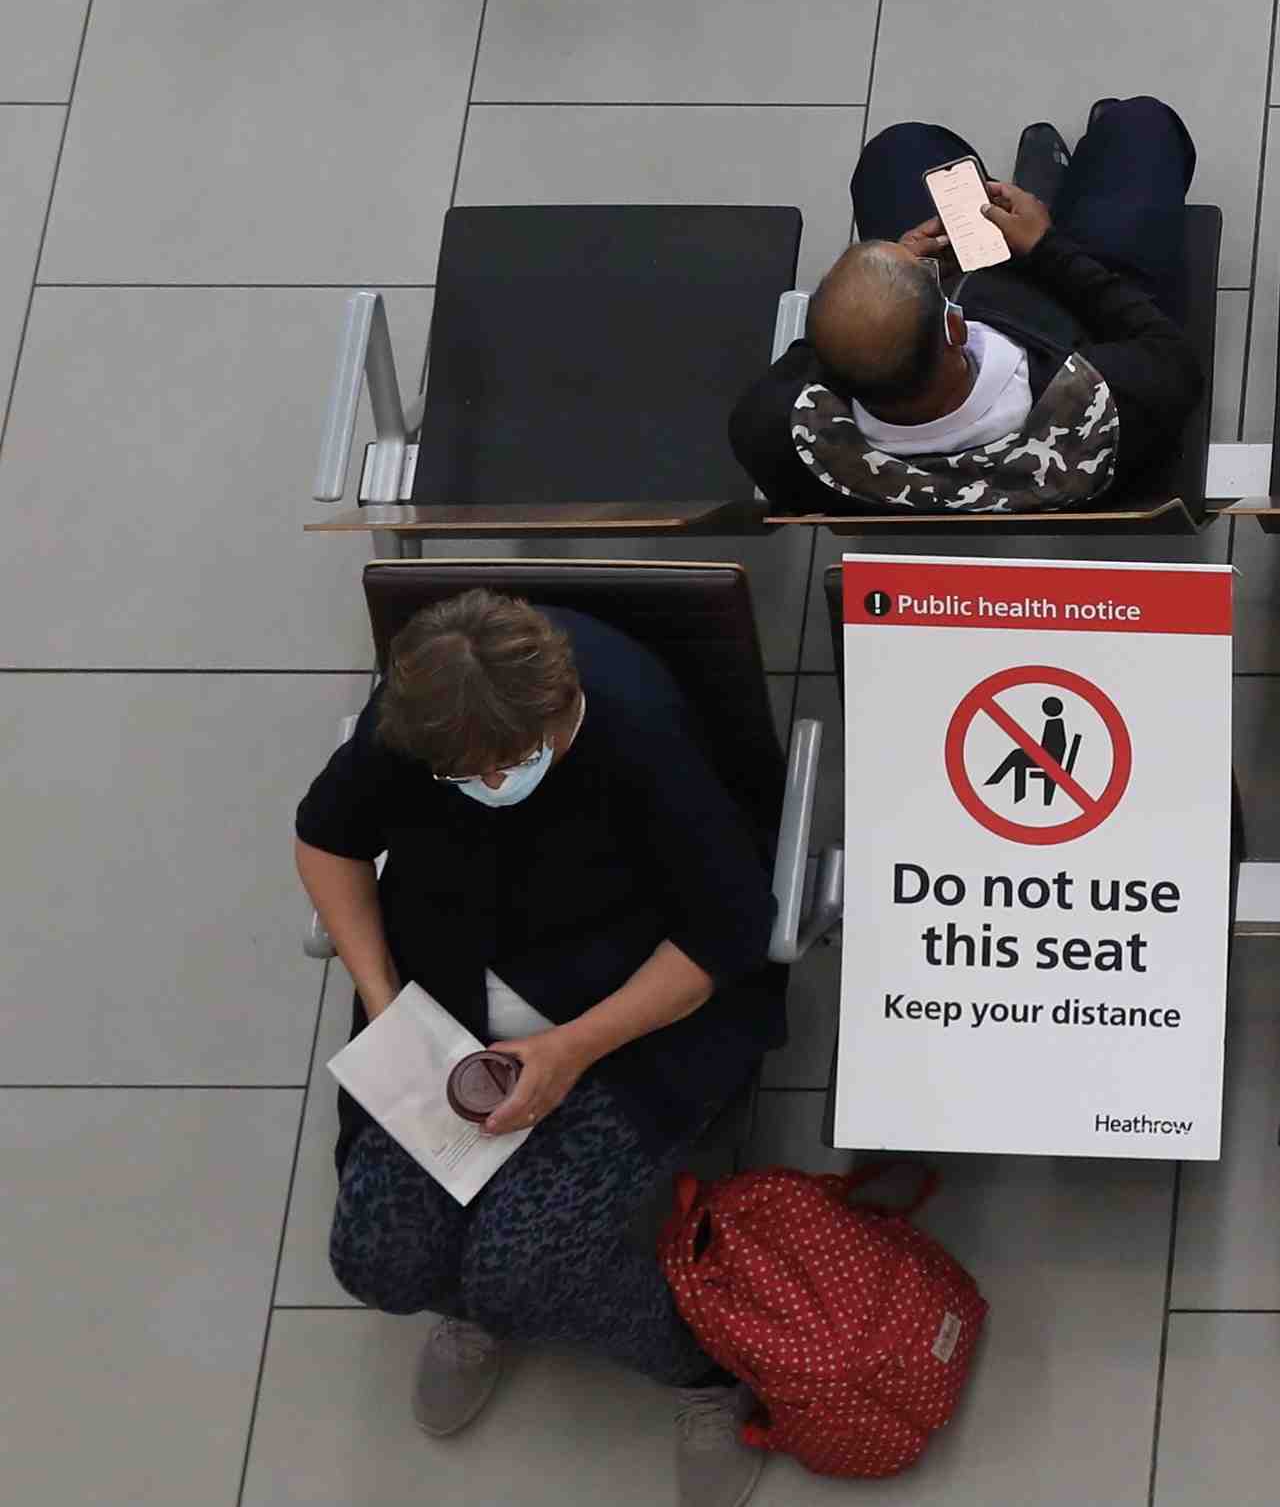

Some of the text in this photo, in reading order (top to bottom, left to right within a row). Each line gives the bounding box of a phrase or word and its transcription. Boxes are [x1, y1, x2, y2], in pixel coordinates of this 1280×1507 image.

[899, 595, 1140, 620] Public health notice
[894, 863, 1180, 913] Do not use
[921, 923, 1147, 972] this seat
[885, 994, 1180, 1028] Keep your distance
[1096, 1114, 1193, 1135] Heathrow
